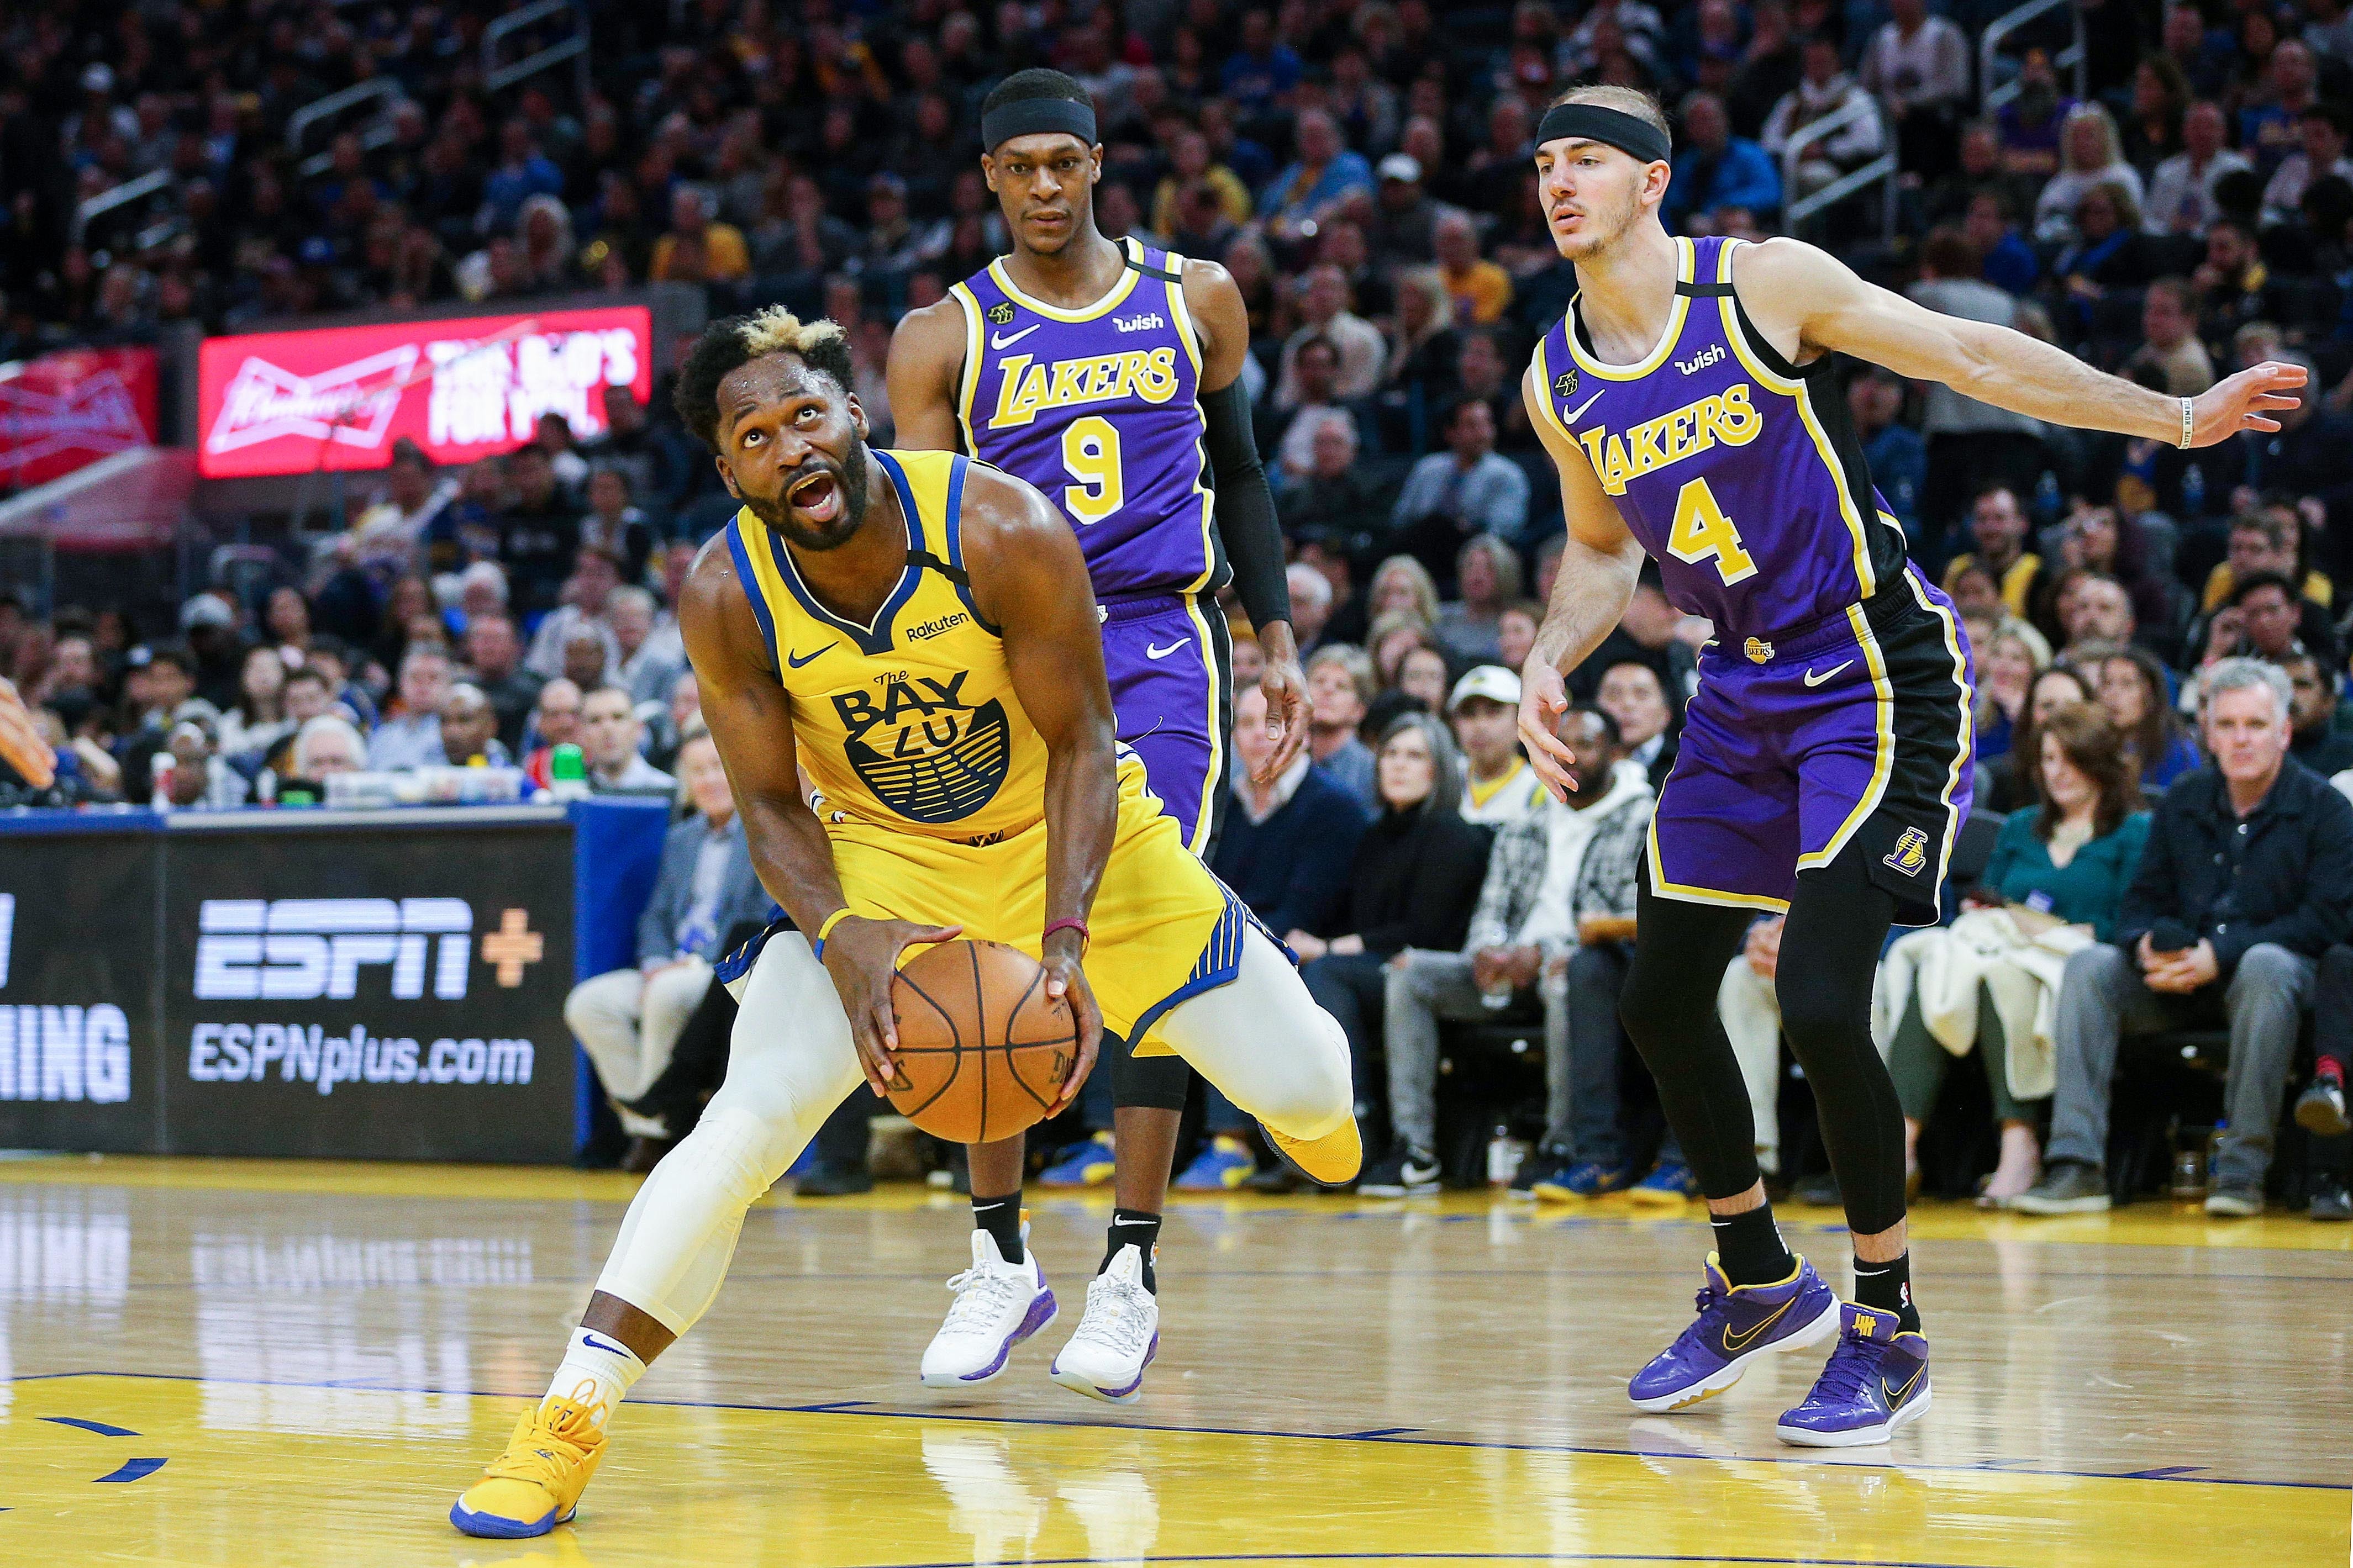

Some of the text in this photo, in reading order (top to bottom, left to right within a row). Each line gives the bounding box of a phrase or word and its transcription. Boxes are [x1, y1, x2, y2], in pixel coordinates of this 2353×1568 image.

[1112, 313, 1164, 332] wish
[988, 347, 1179, 430] LAKERS
[1675, 344, 1725, 376] wish
[1061, 415, 1124, 525] 9
[1580, 384, 1762, 496] LAKERS
[1666, 476, 1759, 588] 4
[906, 612, 969, 642] Rakuten
[831, 670, 969, 731] BAY
[873, 670, 909, 685] The
[189, 1022, 535, 1095] ESPNplus.com
